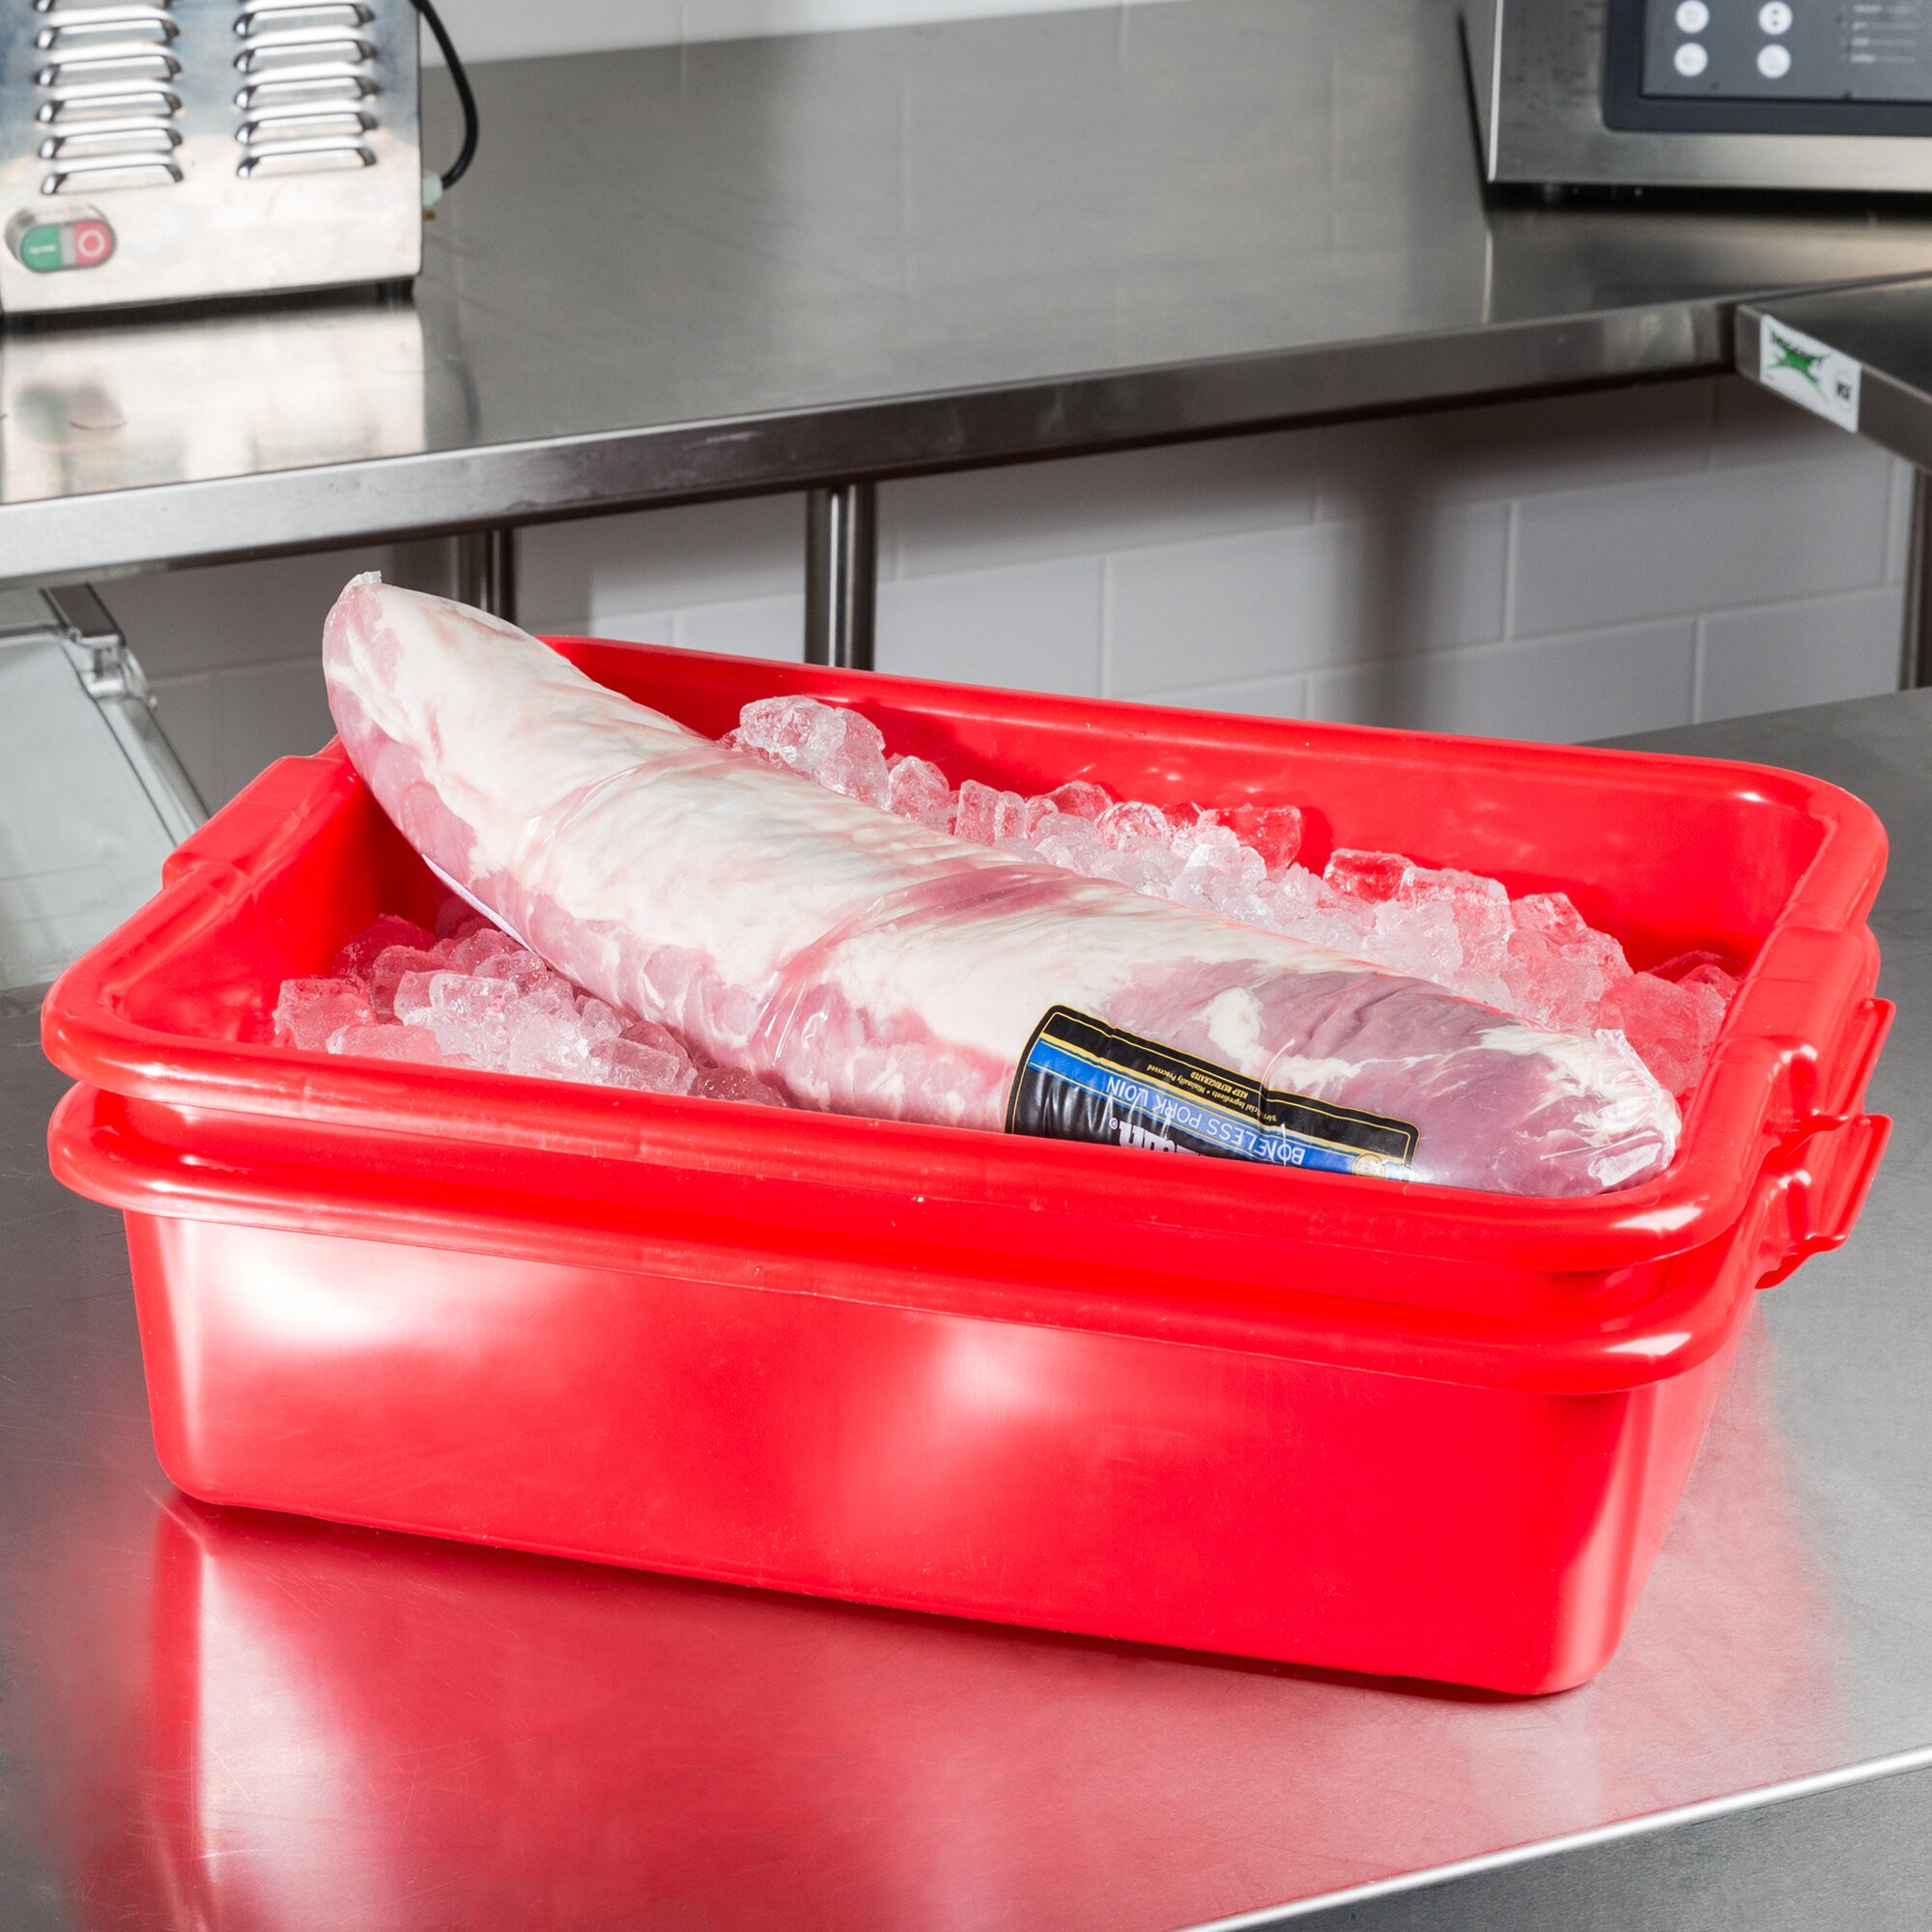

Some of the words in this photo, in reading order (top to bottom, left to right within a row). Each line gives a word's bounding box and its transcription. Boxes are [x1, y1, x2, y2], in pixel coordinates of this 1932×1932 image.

[1146, 1063, 1178, 1082] Processed
[1189, 1070, 1234, 1094] REFRIGERATED
[1106, 1076, 1150, 1107] LOIN
[1176, 1074, 1207, 1094] Minimally
[1232, 1087, 1249, 1100] KEEP
[1210, 1089, 1246, 1110] Ingredients
[1151, 1094, 1203, 1128] PORK
[1205, 1117, 1306, 1165] BONELESS
